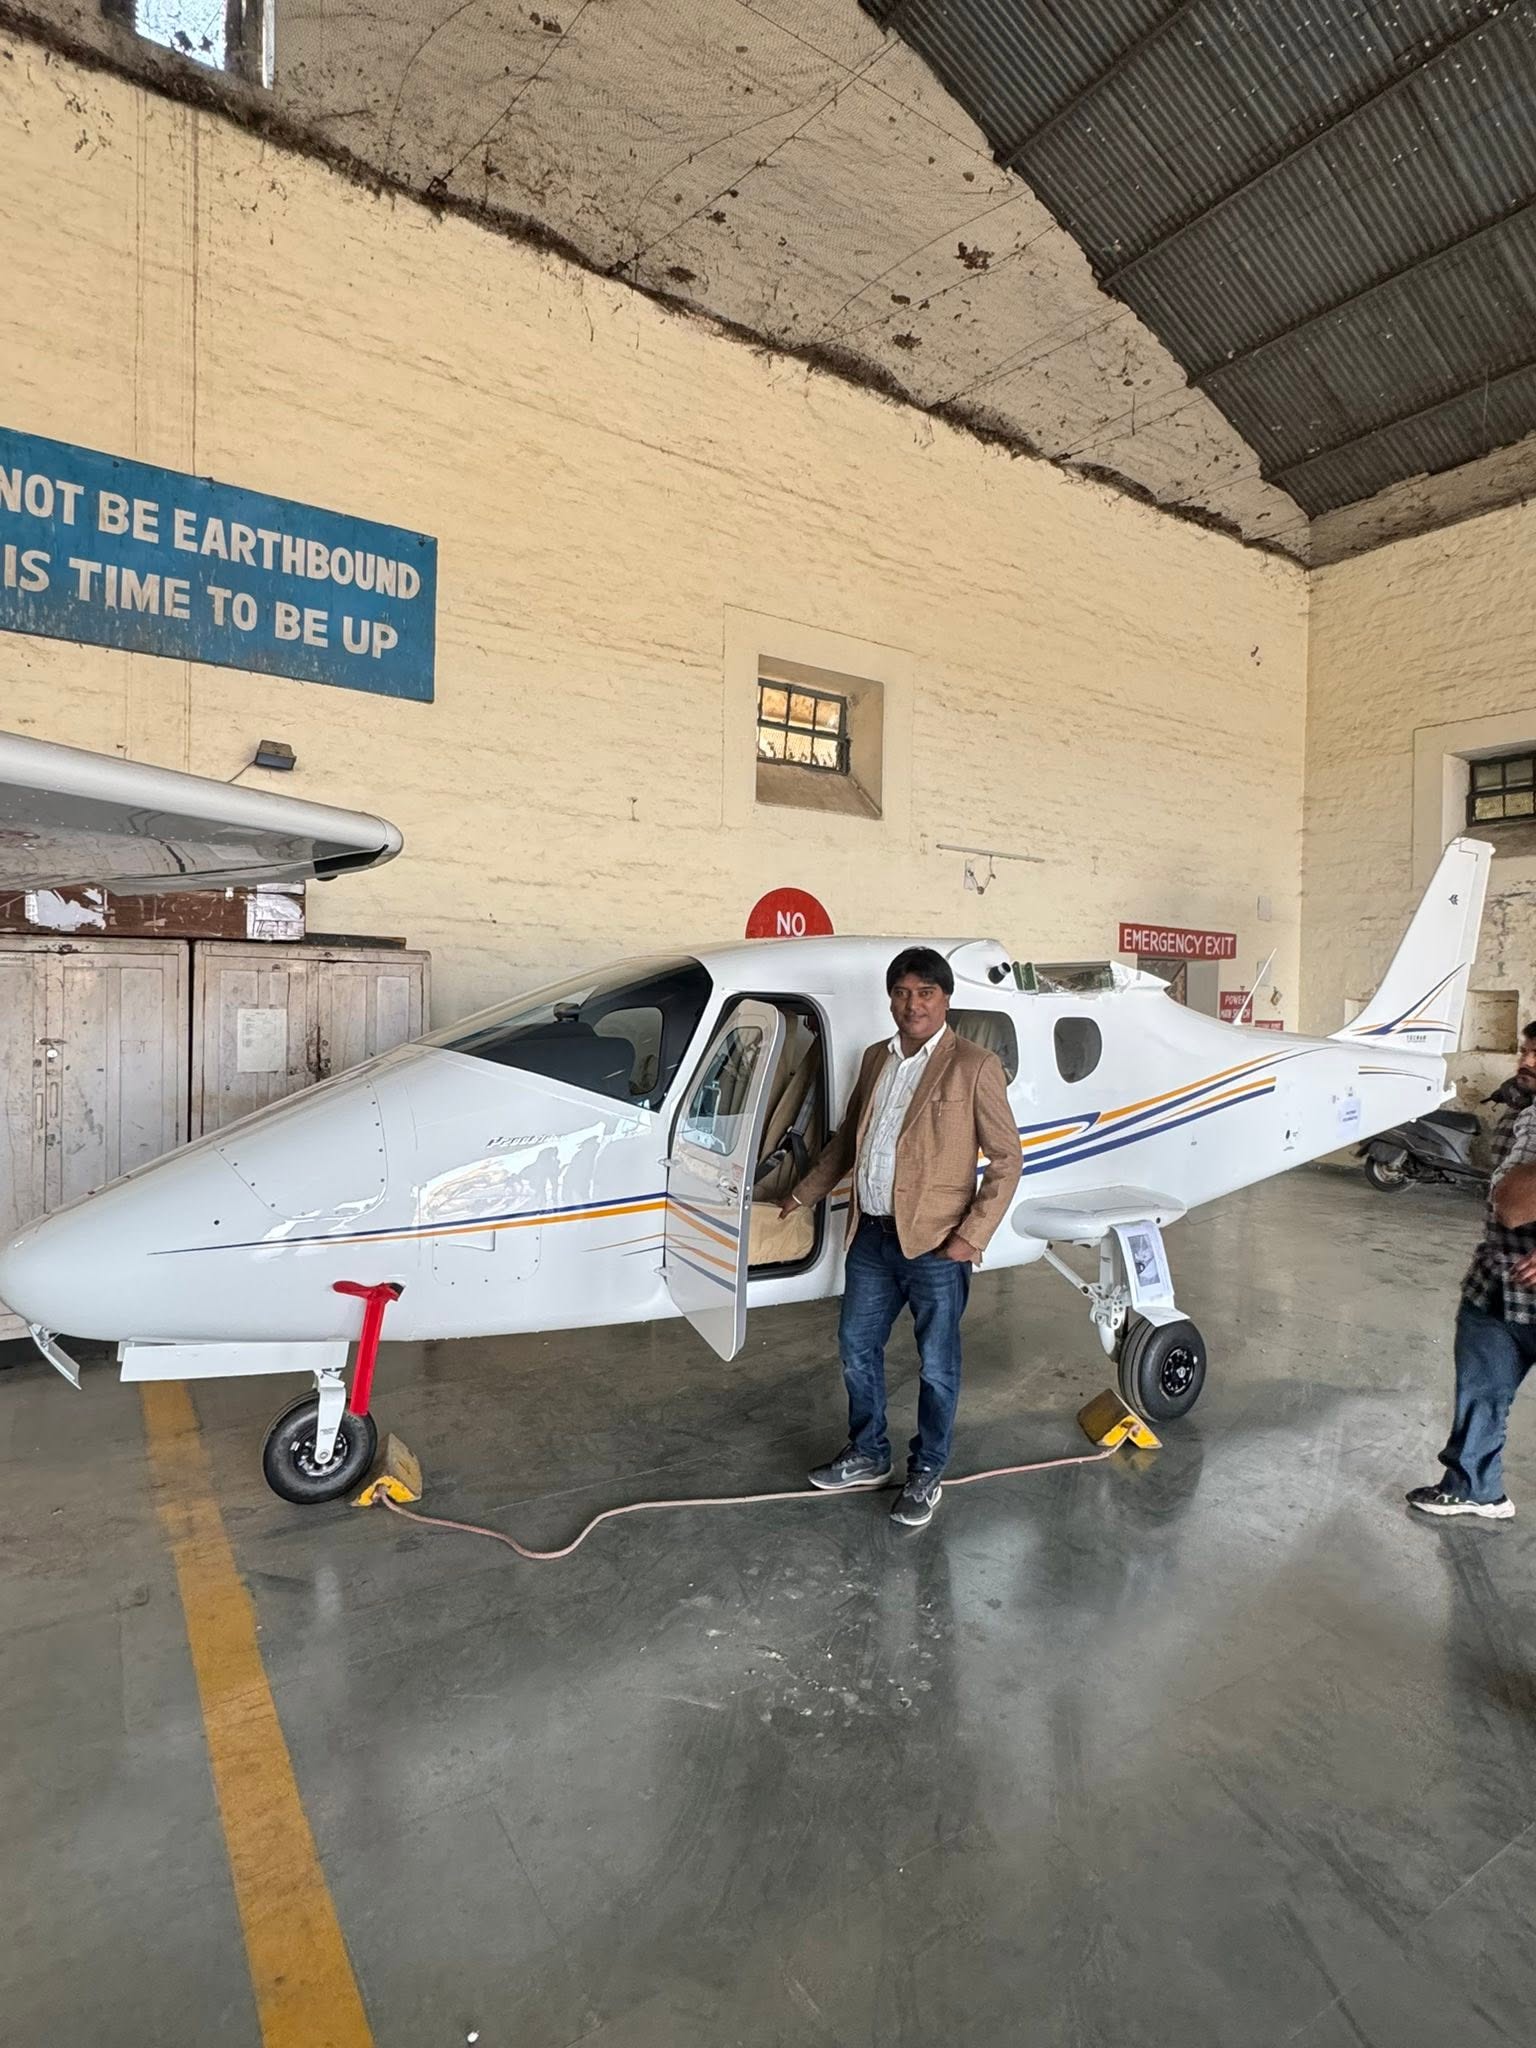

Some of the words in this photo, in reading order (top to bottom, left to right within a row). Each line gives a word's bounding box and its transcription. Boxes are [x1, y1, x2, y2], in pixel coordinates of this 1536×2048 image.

[98, 490, 159, 544] BE
[174, 508, 420, 600] EARTHBOUND
[4, 544, 51, 592] IS
[69, 557, 190, 620] TIME
[207, 586, 258, 631] TO
[275, 601, 328, 648] BE
[342, 615, 398, 659] UP
[776, 910, 806, 936] NO
[1124, 928, 1203, 955] EMERGENCY
[1205, 936, 1234, 956] EXIT
